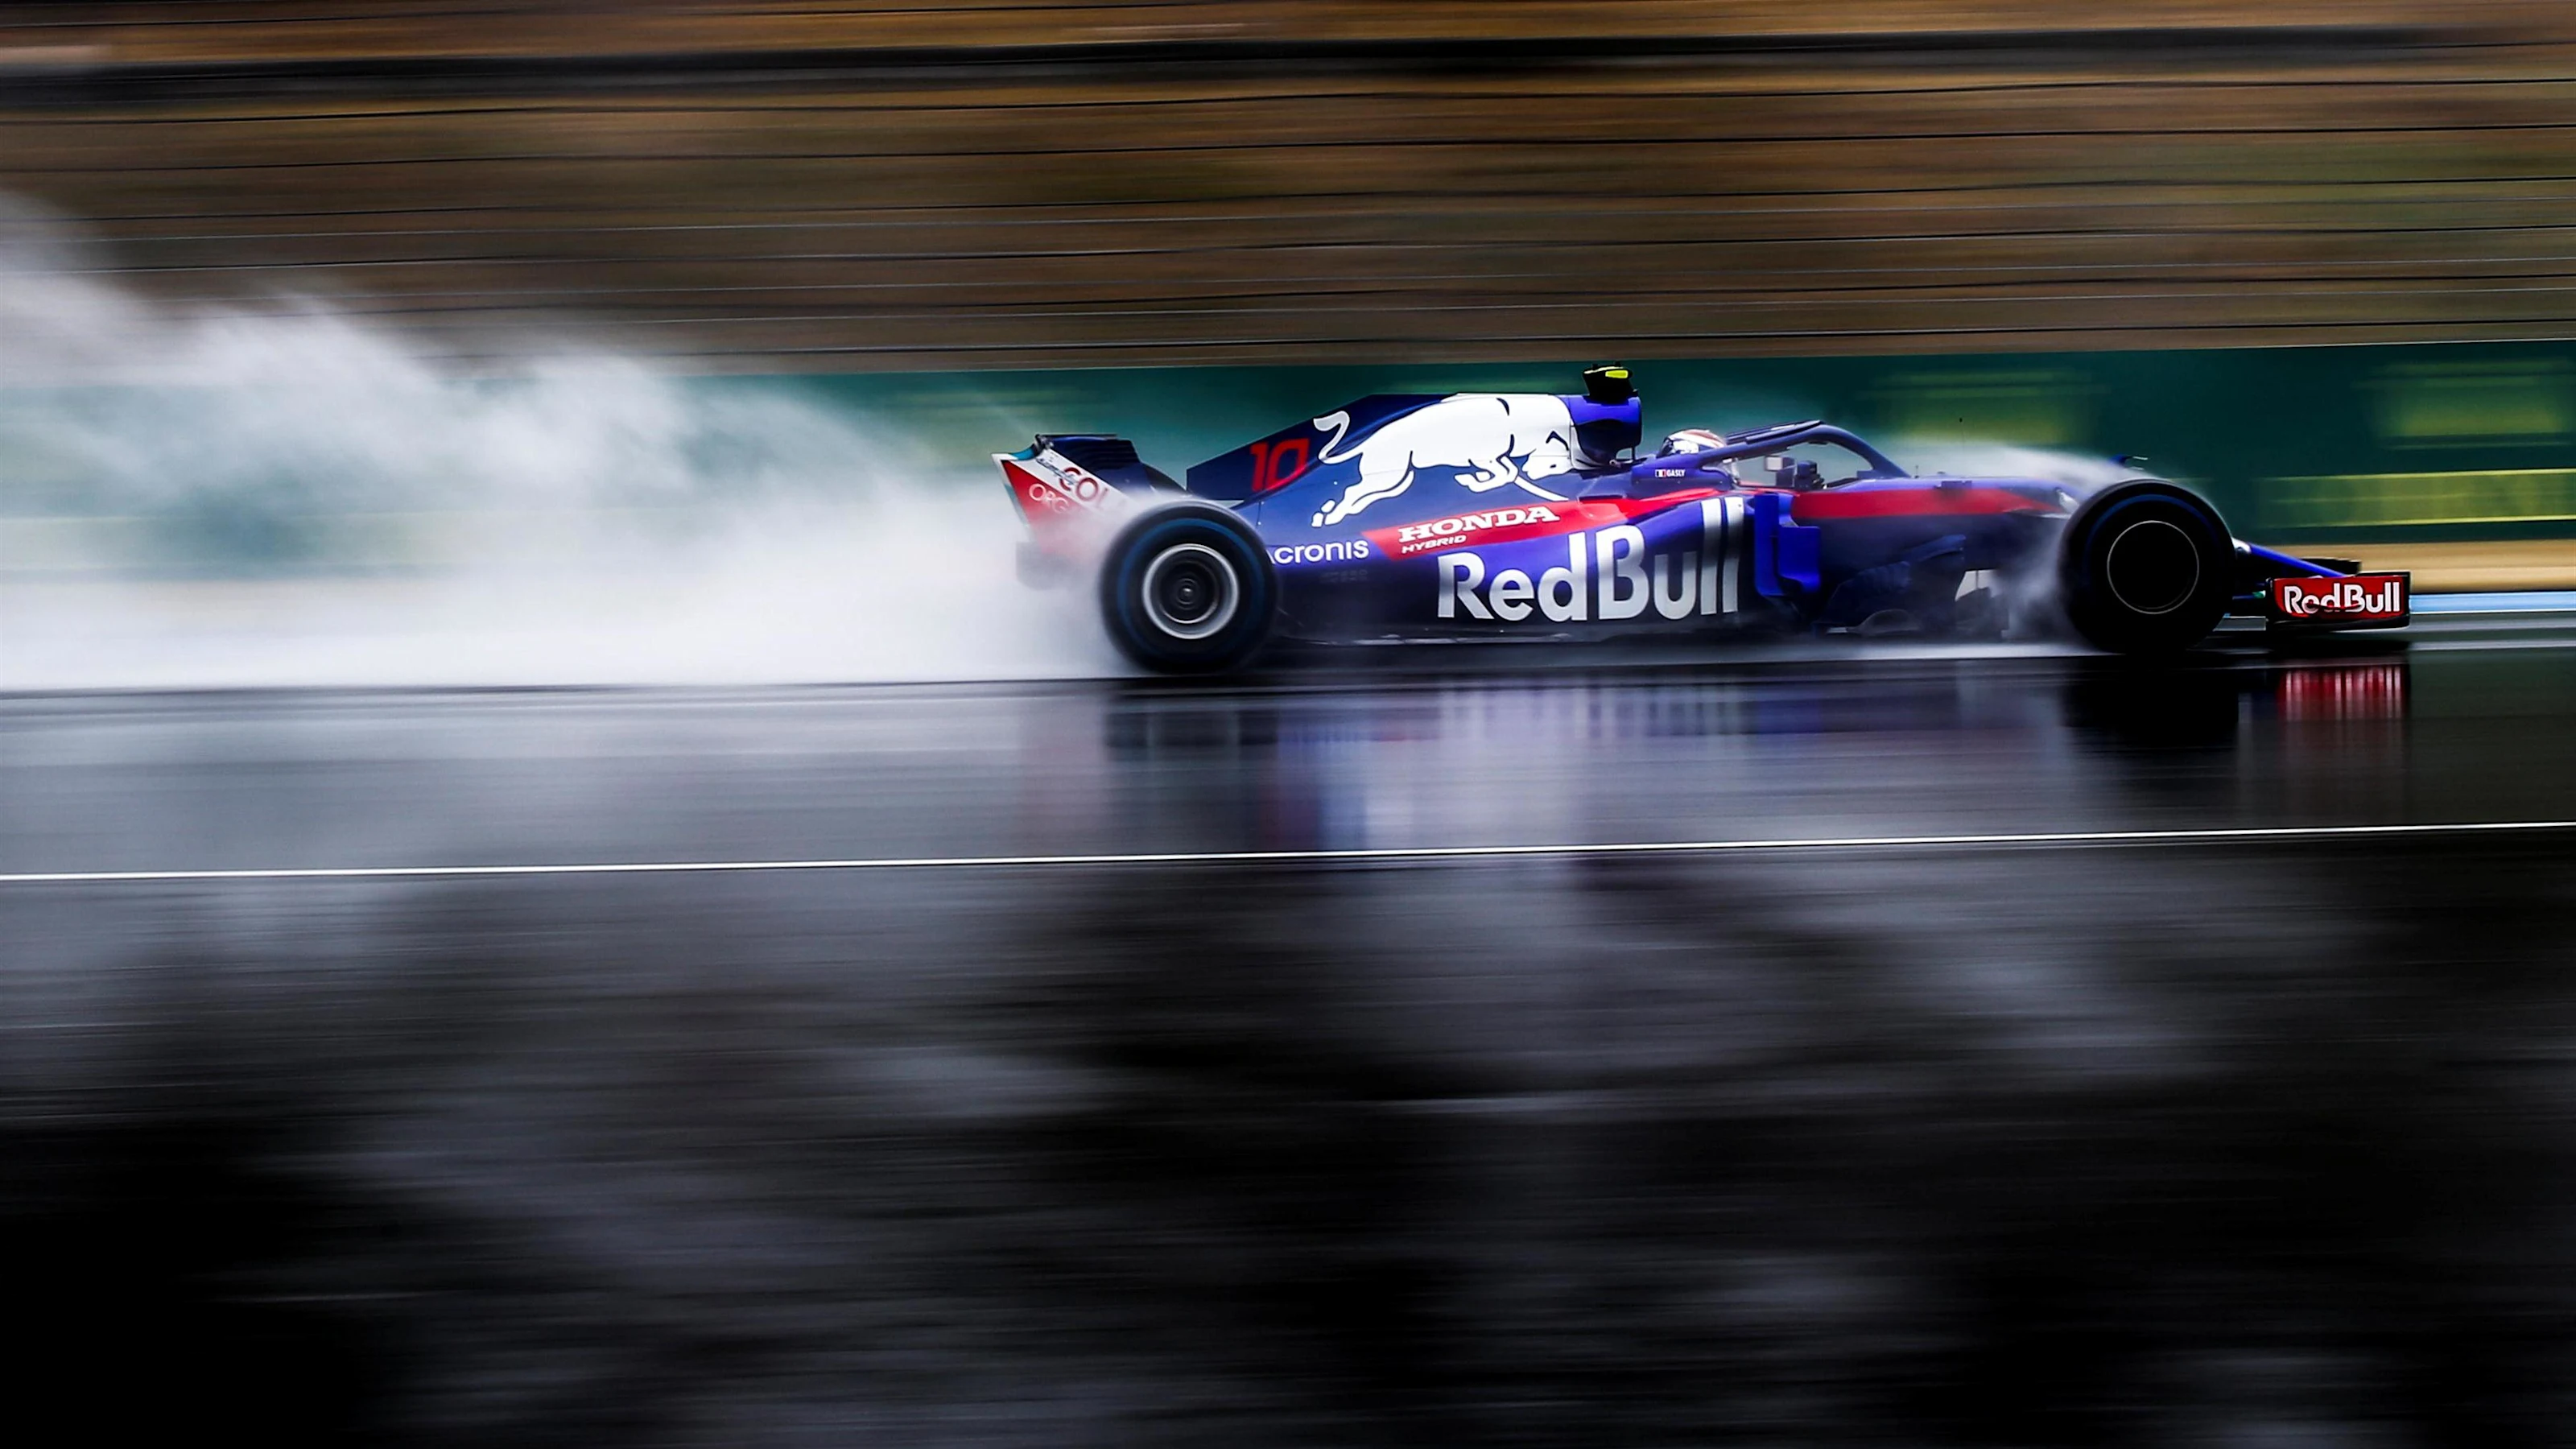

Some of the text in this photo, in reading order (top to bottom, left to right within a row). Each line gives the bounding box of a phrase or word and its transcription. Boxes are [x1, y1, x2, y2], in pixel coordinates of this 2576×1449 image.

[1250, 438, 1309, 493] 10
[1666, 469, 1686, 477] GASLY
[1397, 506, 1560, 543] HONDA
[1265, 539, 1369, 564] cronis
[1402, 535, 1467, 554] HYBRID
